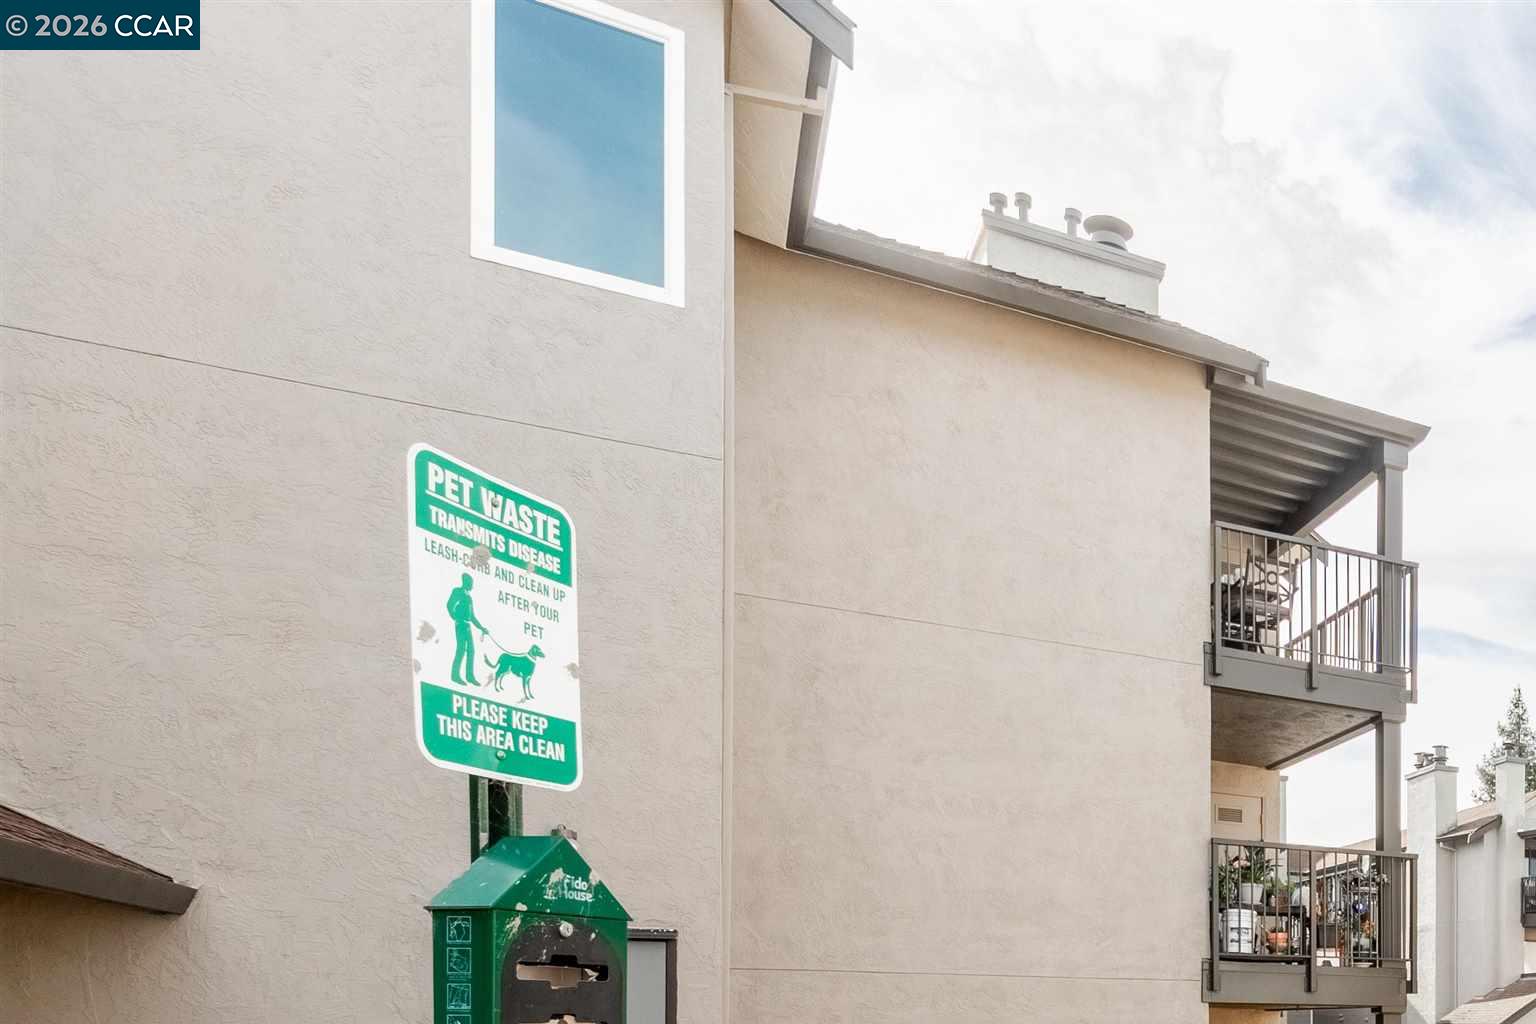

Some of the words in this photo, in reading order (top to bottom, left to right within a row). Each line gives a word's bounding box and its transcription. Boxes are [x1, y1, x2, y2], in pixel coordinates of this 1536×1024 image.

[428, 461, 474, 508] PET
[480, 486, 561, 546] WASTE
[429, 504, 506, 553] TRANSMITS
[508, 539, 561, 575] DISEASE
[494, 566, 515, 585] AND
[518, 574, 550, 597] CLEAN
[552, 587, 566, 602] UP
[497, 590, 530, 612] AFTER
[532, 602, 560, 623] YOUR
[523, 621, 544, 640] PET
[452, 694, 508, 727] PLEASE
[511, 709, 549, 736] KEEP
[436, 713, 472, 742] THIS
[476, 724, 515, 752] AREA
[518, 734, 566, 762] CLEAN
